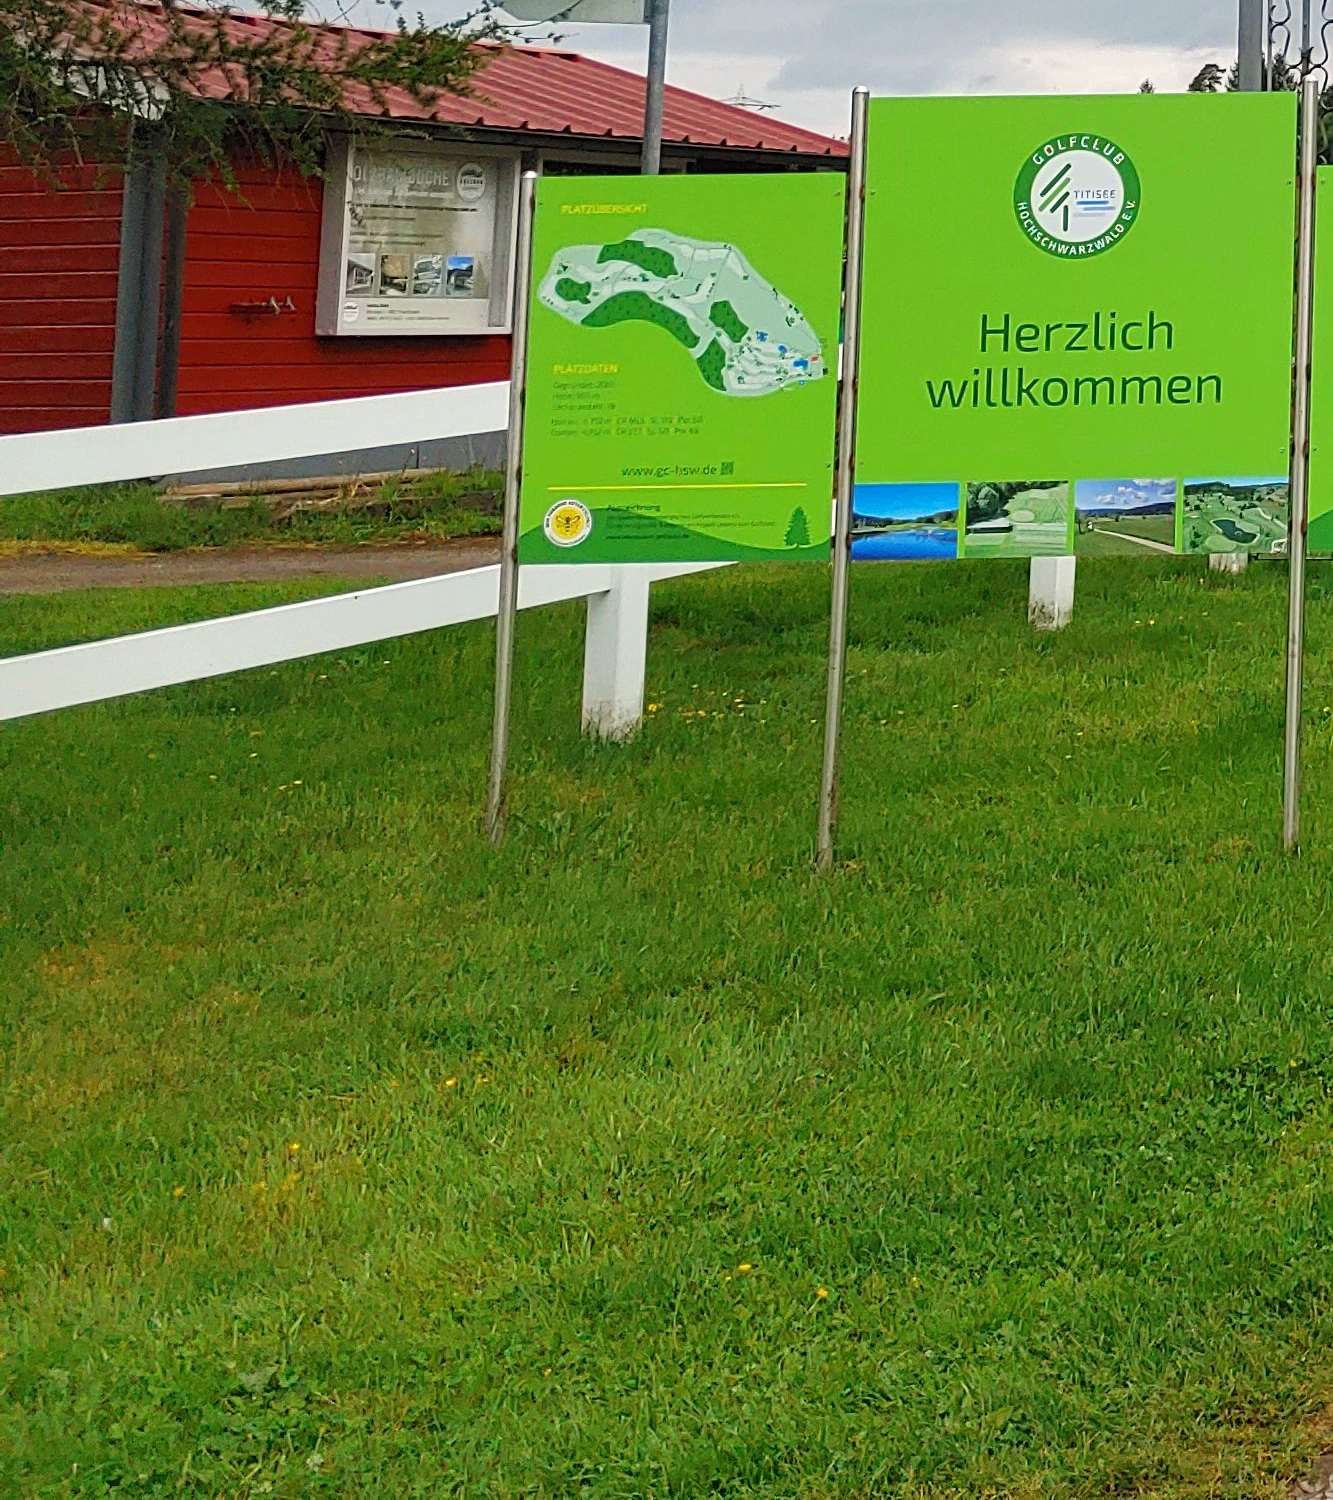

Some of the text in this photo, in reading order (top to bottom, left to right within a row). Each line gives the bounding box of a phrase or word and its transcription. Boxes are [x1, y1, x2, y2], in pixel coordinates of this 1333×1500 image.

[1032, 136, 1125, 165] GOLFCLUB
[1073, 189, 1117, 199] TITISEE
[1017, 201, 1125, 256] HOCHSCHWARZWALD
[979, 310, 1175, 352] Herzlich
[553, 364, 619, 374] PLATZDATEN
[925, 367, 1223, 409] willkommen
[621, 465, 718, 479] www.gc-hsw.de
